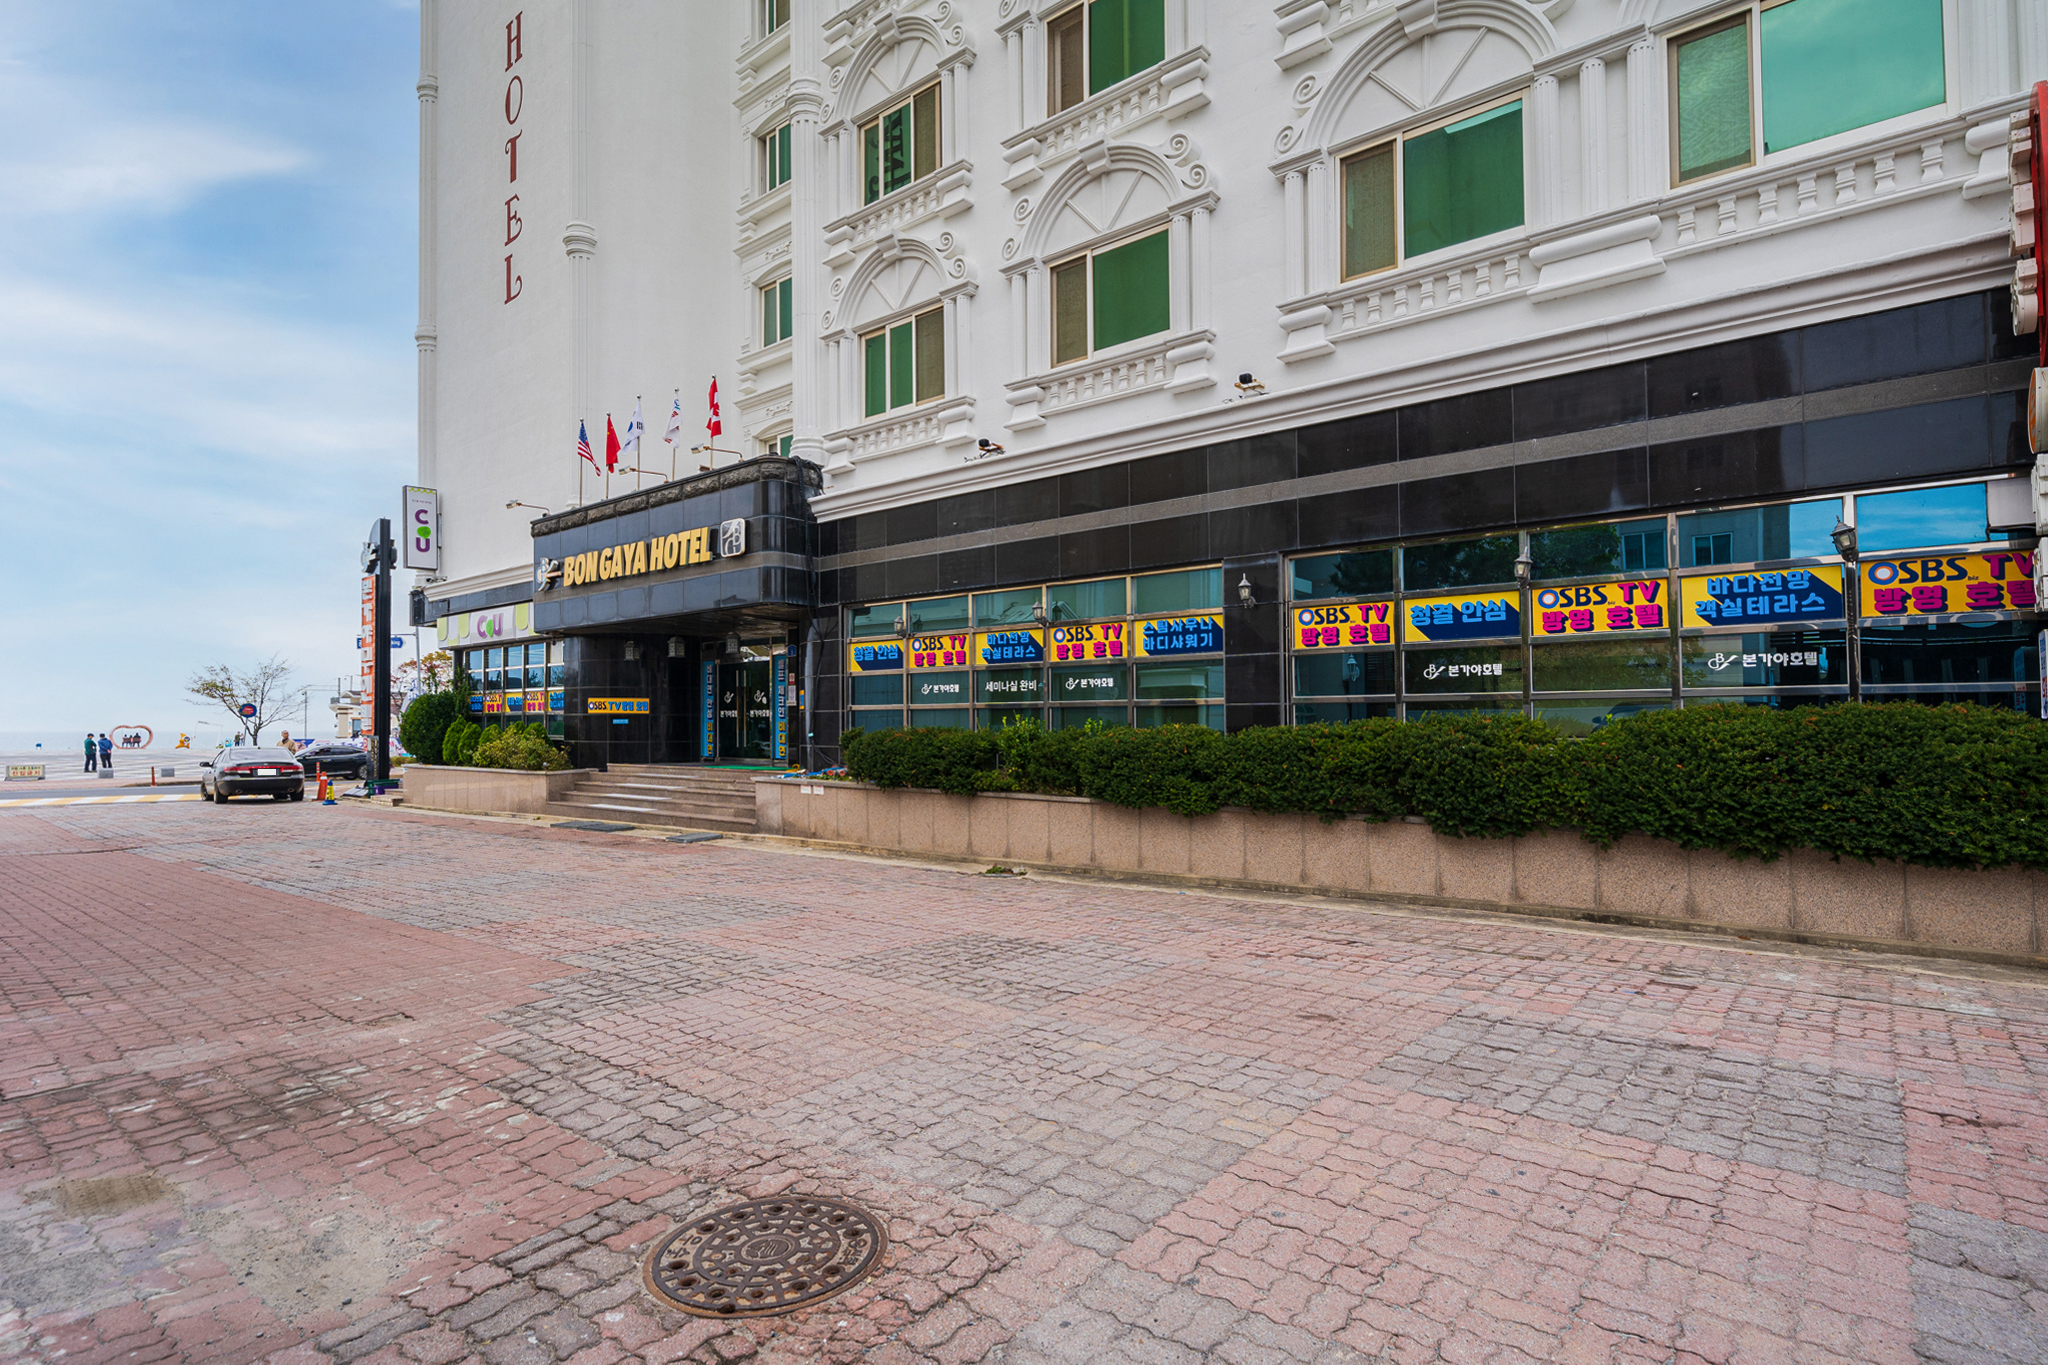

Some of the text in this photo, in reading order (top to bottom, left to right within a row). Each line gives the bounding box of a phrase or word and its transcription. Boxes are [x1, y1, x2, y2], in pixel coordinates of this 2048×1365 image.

[504, 10, 523, 305] HOTEL
[649, 527, 713, 571] HOTEL
[1898, 557, 1968, 584] SBS
[1982, 552, 2034, 580] TV
[1706, 570, 1811, 595] 바다전망
[1559, 585, 1608, 608] SBS
[1617, 581, 1661, 604] TV
[1874, 580, 2036, 613] 방영 호텔
[1314, 603, 1389, 625] SBS TV
[1410, 598, 1507, 626] 청결 안심
[1695, 592, 1826, 618] 객실테라스
[1142, 616, 1213, 634] 스팀사우나
[1542, 604, 1662, 632] 방영 호텔
[987, 631, 1030, 645] 바다전망
[1066, 623, 1123, 642] SBS TV
[1142, 632, 1213, 650] 바디샤워기
[1301, 623, 1389, 647] 방영 호텔
[877, 644, 899, 660] 안심
[922, 635, 966, 651] SBS TV
[981, 645, 1036, 660] 객실테라스
[1093, 640, 1122, 658] 호텔
[1742, 651, 1818, 667] 본가야호텔
[1448, 663, 1502, 677] 본가야호텔
[985, 680, 1037, 692] 세미나실 완비
